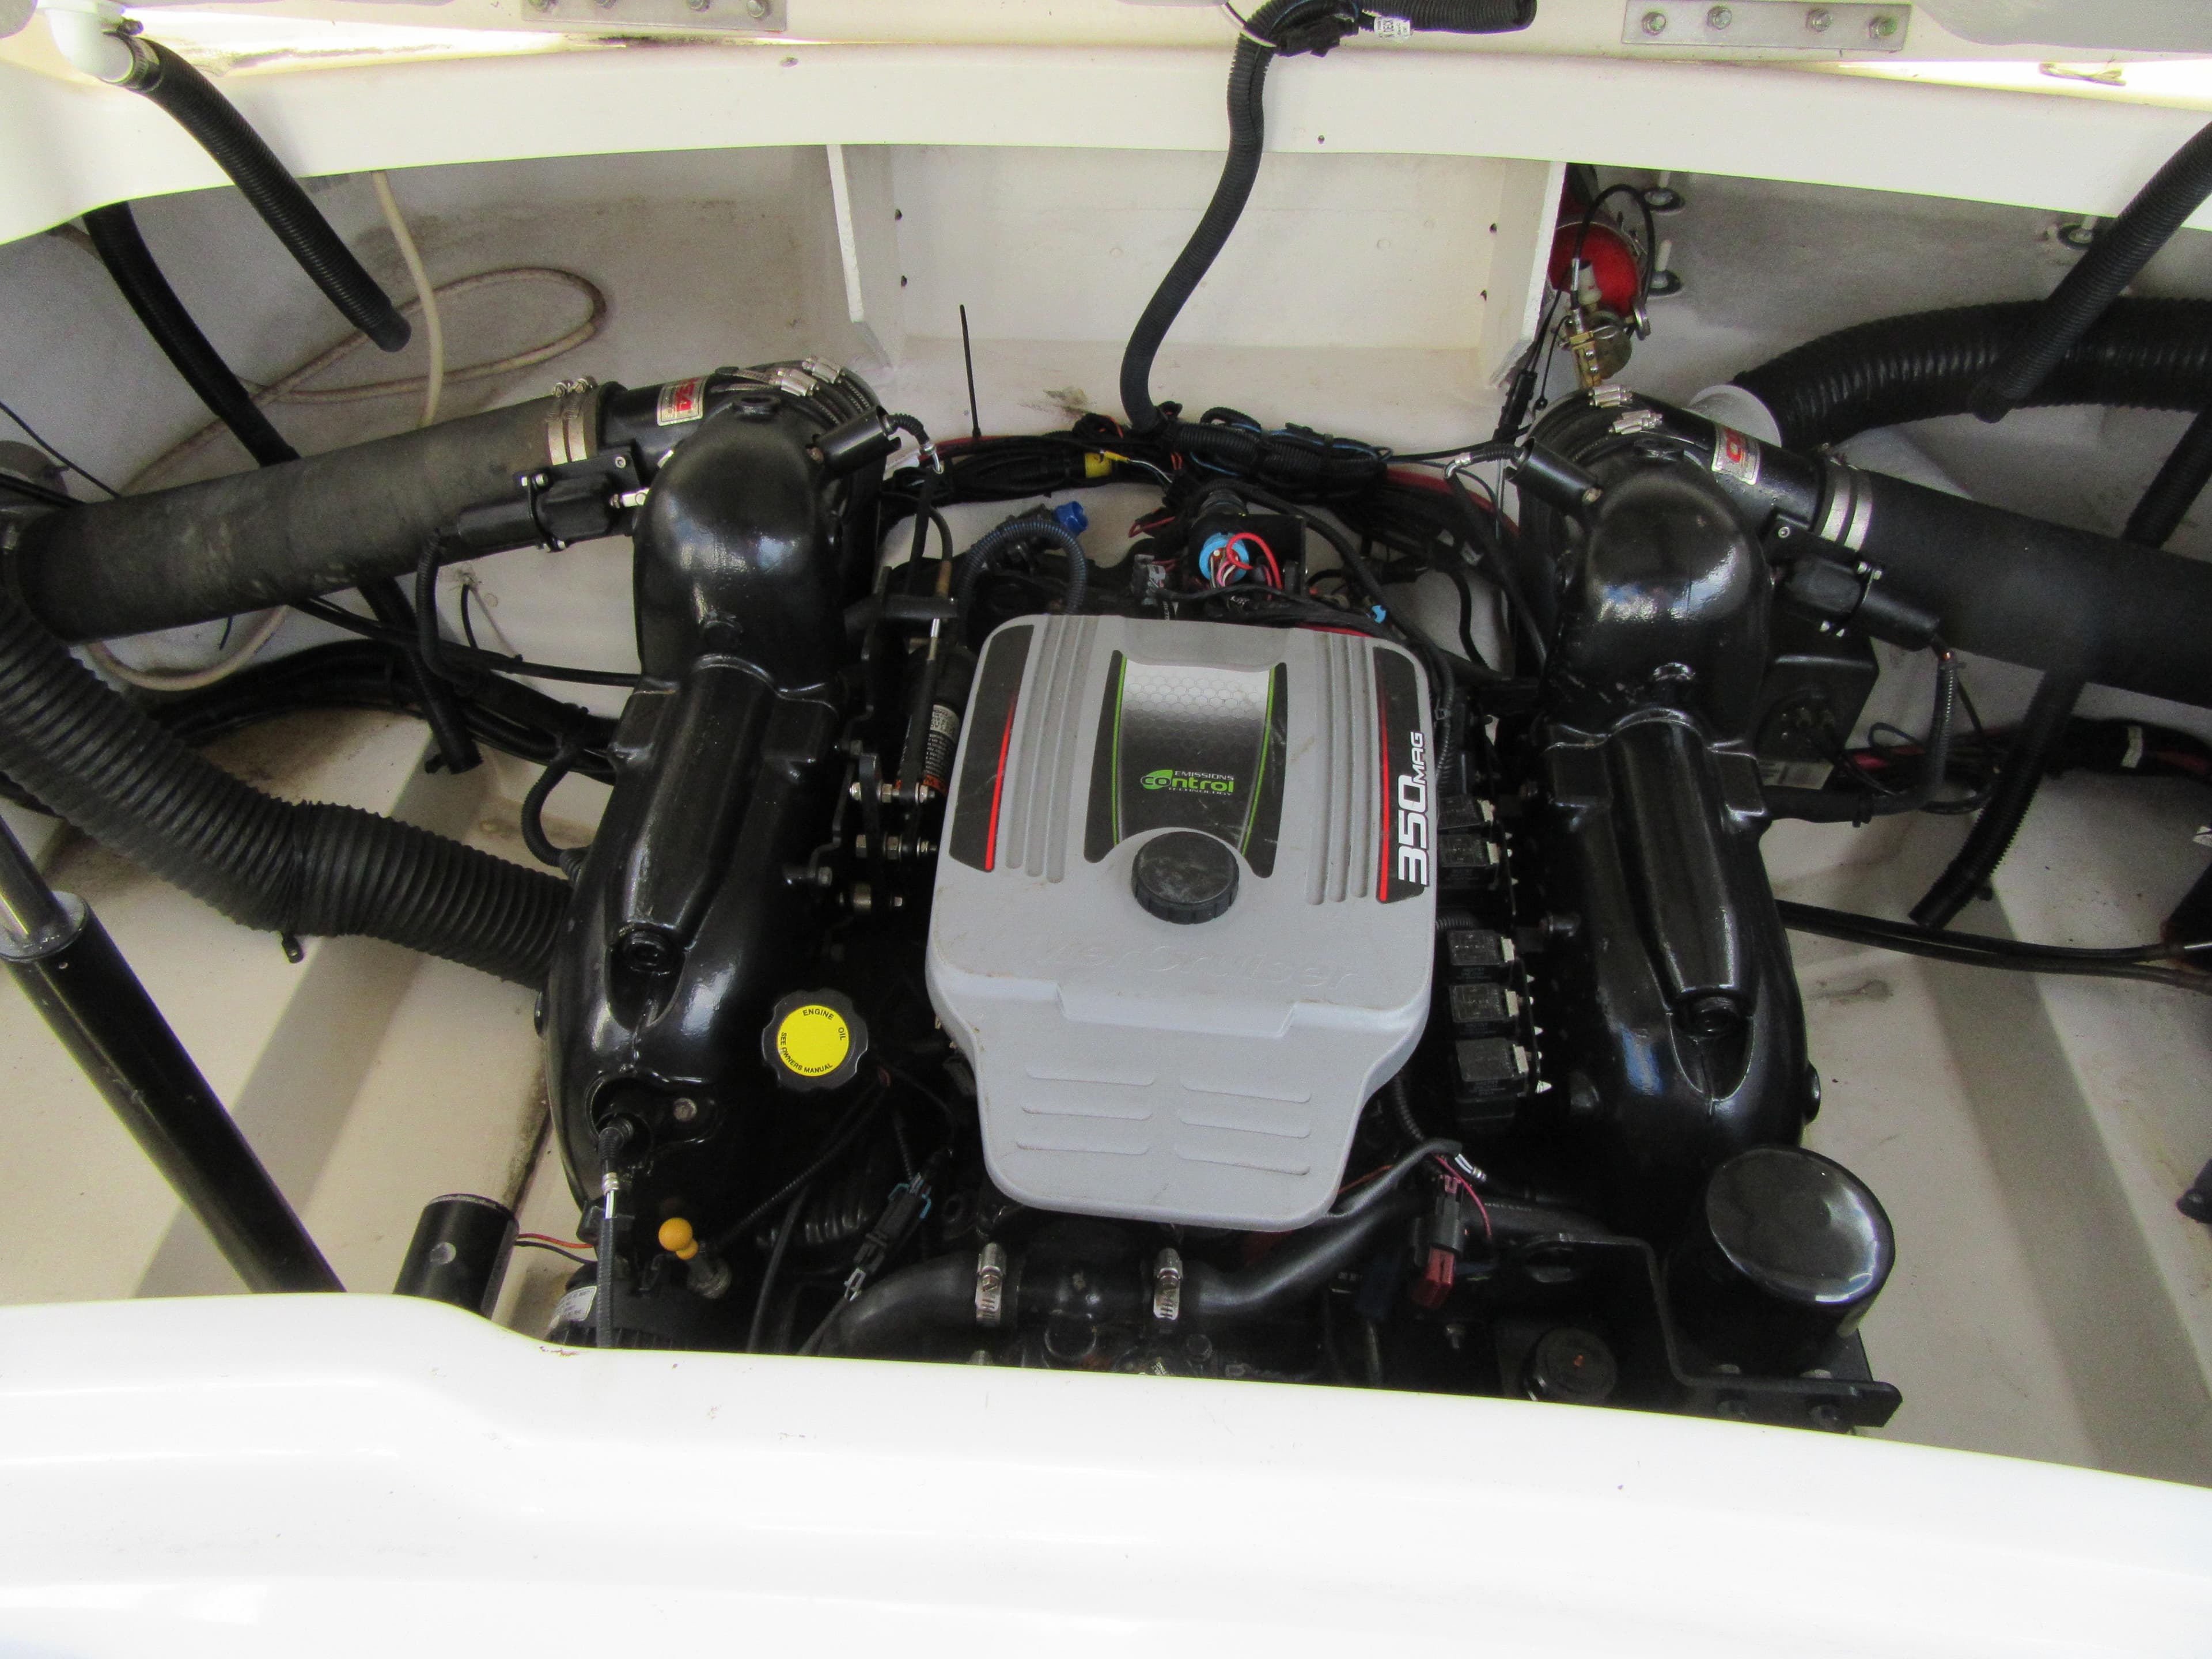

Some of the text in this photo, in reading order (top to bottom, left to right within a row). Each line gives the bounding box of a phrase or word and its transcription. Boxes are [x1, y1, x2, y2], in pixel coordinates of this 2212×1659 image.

[1140, 775, 1234, 793] control
[1175, 770, 1234, 781] EMISSIONS
[1397, 731, 1428, 886] 350 MAG
[802, 1008, 846, 1041] ENGINE OIL
[782, 1047, 802, 1070] OWNERS
[804, 1062, 833, 1073] MANUAL
